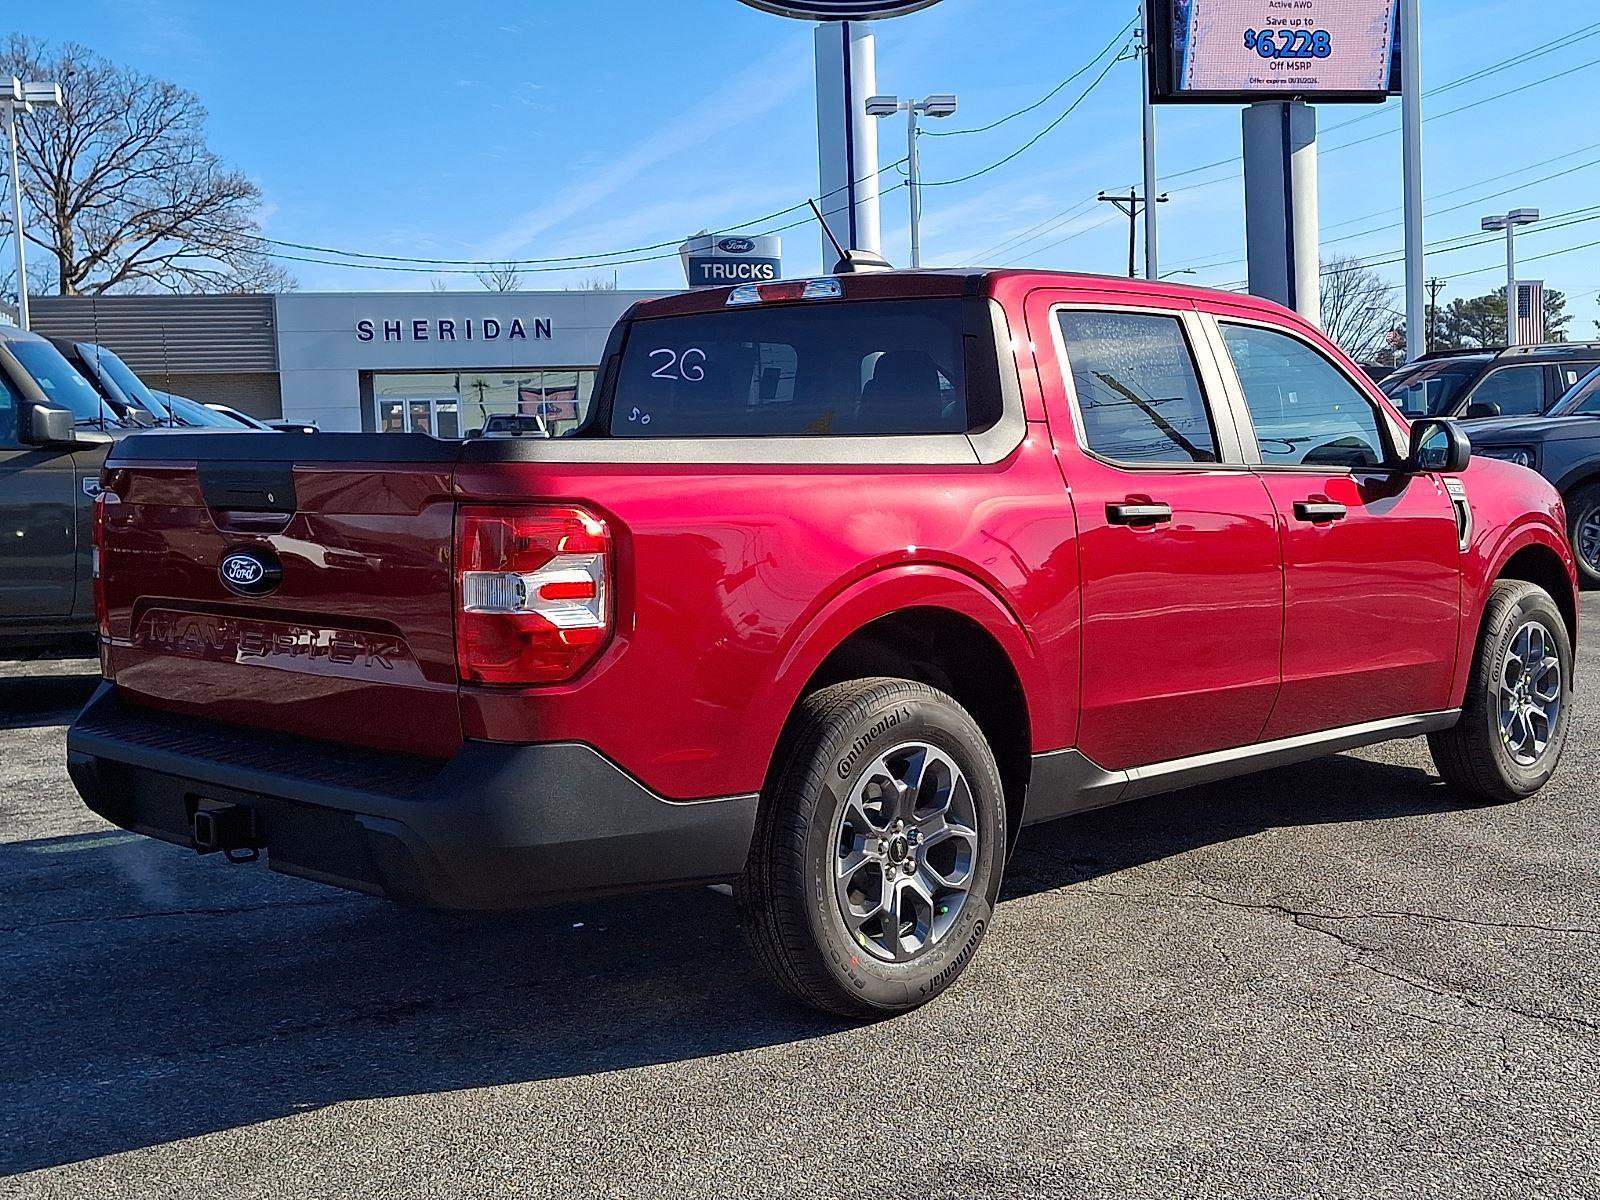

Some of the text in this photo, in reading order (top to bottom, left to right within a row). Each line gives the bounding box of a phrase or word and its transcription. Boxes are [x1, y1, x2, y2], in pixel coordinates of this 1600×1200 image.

[1269, 0, 1312, 9] Active AWD
[1266, 16, 1314, 28] Save up to
[1243, 29, 1332, 59] $6,228
[1269, 61, 1312, 71] Off MSRP
[725, 239, 749, 251] Ford
[700, 262, 774, 280] TRUCKS
[356, 317, 553, 343] SHERIDAN
[228, 558, 258, 581] Ford
[1492, 620, 1515, 684] Continental
[836, 708, 902, 780] Continental
[928, 918, 985, 993] Continental
